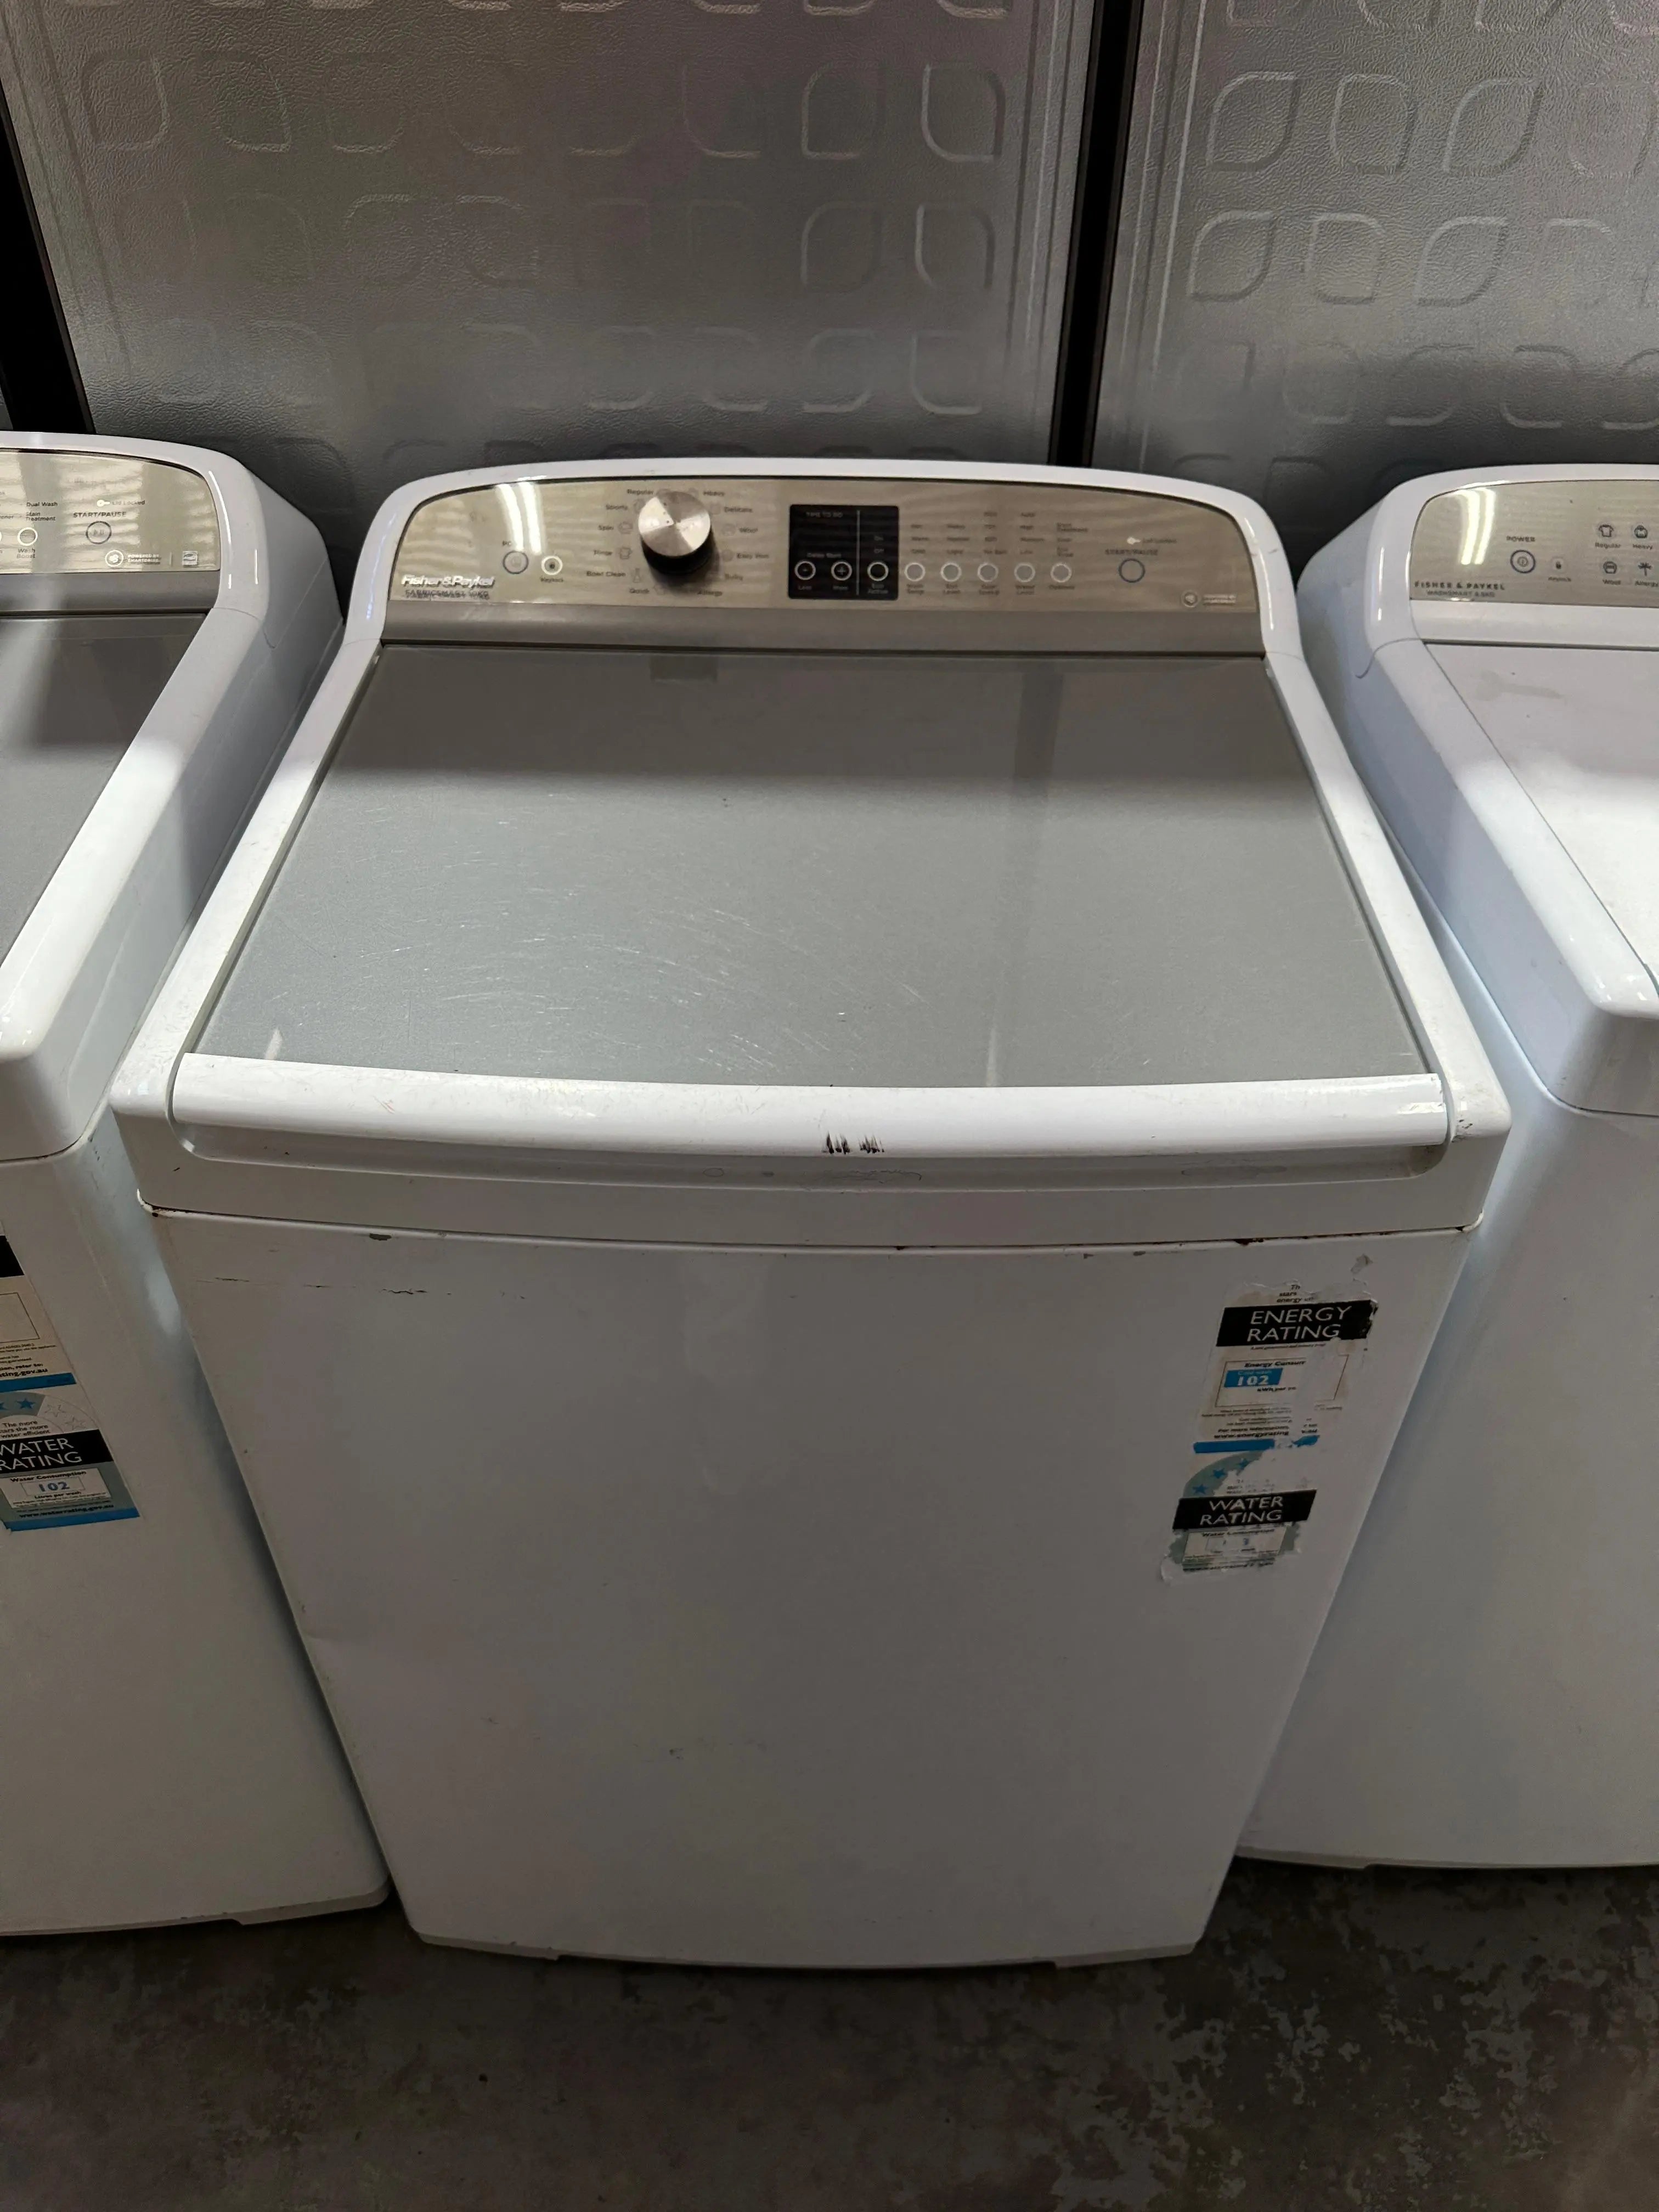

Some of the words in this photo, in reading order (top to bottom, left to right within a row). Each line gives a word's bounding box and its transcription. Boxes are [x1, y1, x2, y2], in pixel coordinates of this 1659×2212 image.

[1414, 581, 1453, 589] FISHER
[1466, 583, 1505, 591] PAYKEL
[1250, 1306, 1352, 1325] ENERGY
[1246, 1324, 1341, 1342] RATING
[1237, 1375, 1268, 1386] 102
[0, 1438, 74, 1457] WATER
[0, 1452, 82, 1471] RATING
[36, 1470, 87, 1480] Consumption
[38, 1481, 70, 1492] 102
[1209, 1496, 1283, 1511] WATER
[1200, 1509, 1283, 1526] RATING
